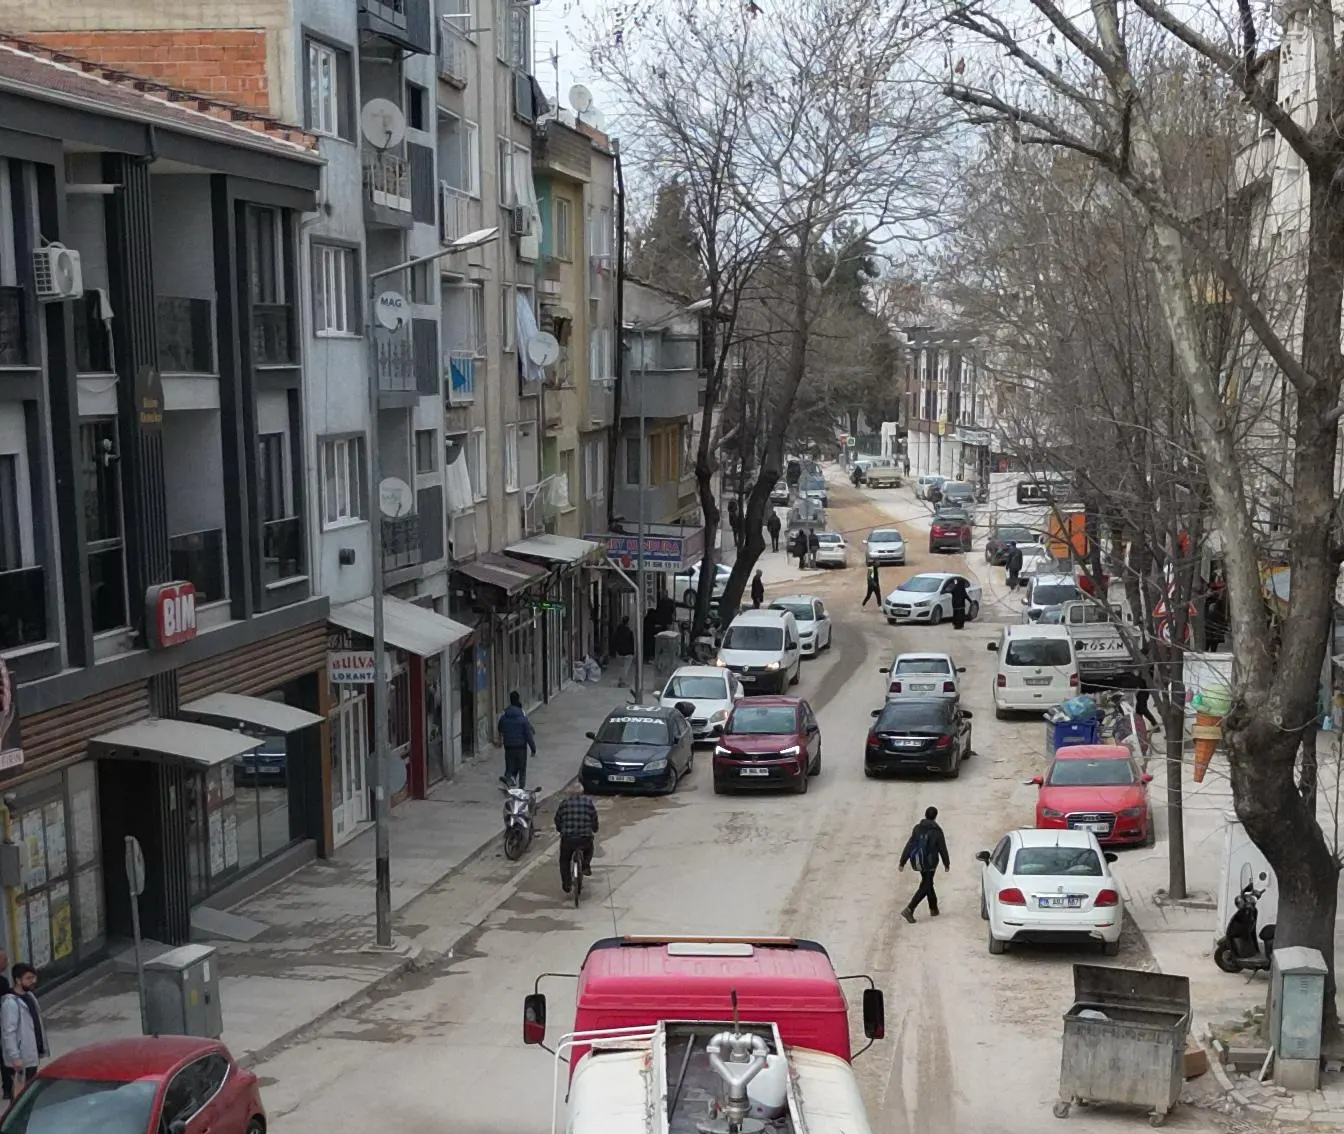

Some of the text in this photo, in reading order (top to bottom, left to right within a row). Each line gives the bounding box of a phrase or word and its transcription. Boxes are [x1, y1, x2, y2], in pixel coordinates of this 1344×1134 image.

[380, 296, 402, 308] MAG
[1081, 642, 1125, 651] TOSAN
[332, 655, 375, 669] BULVA
[609, 717, 665, 725] HONDA
